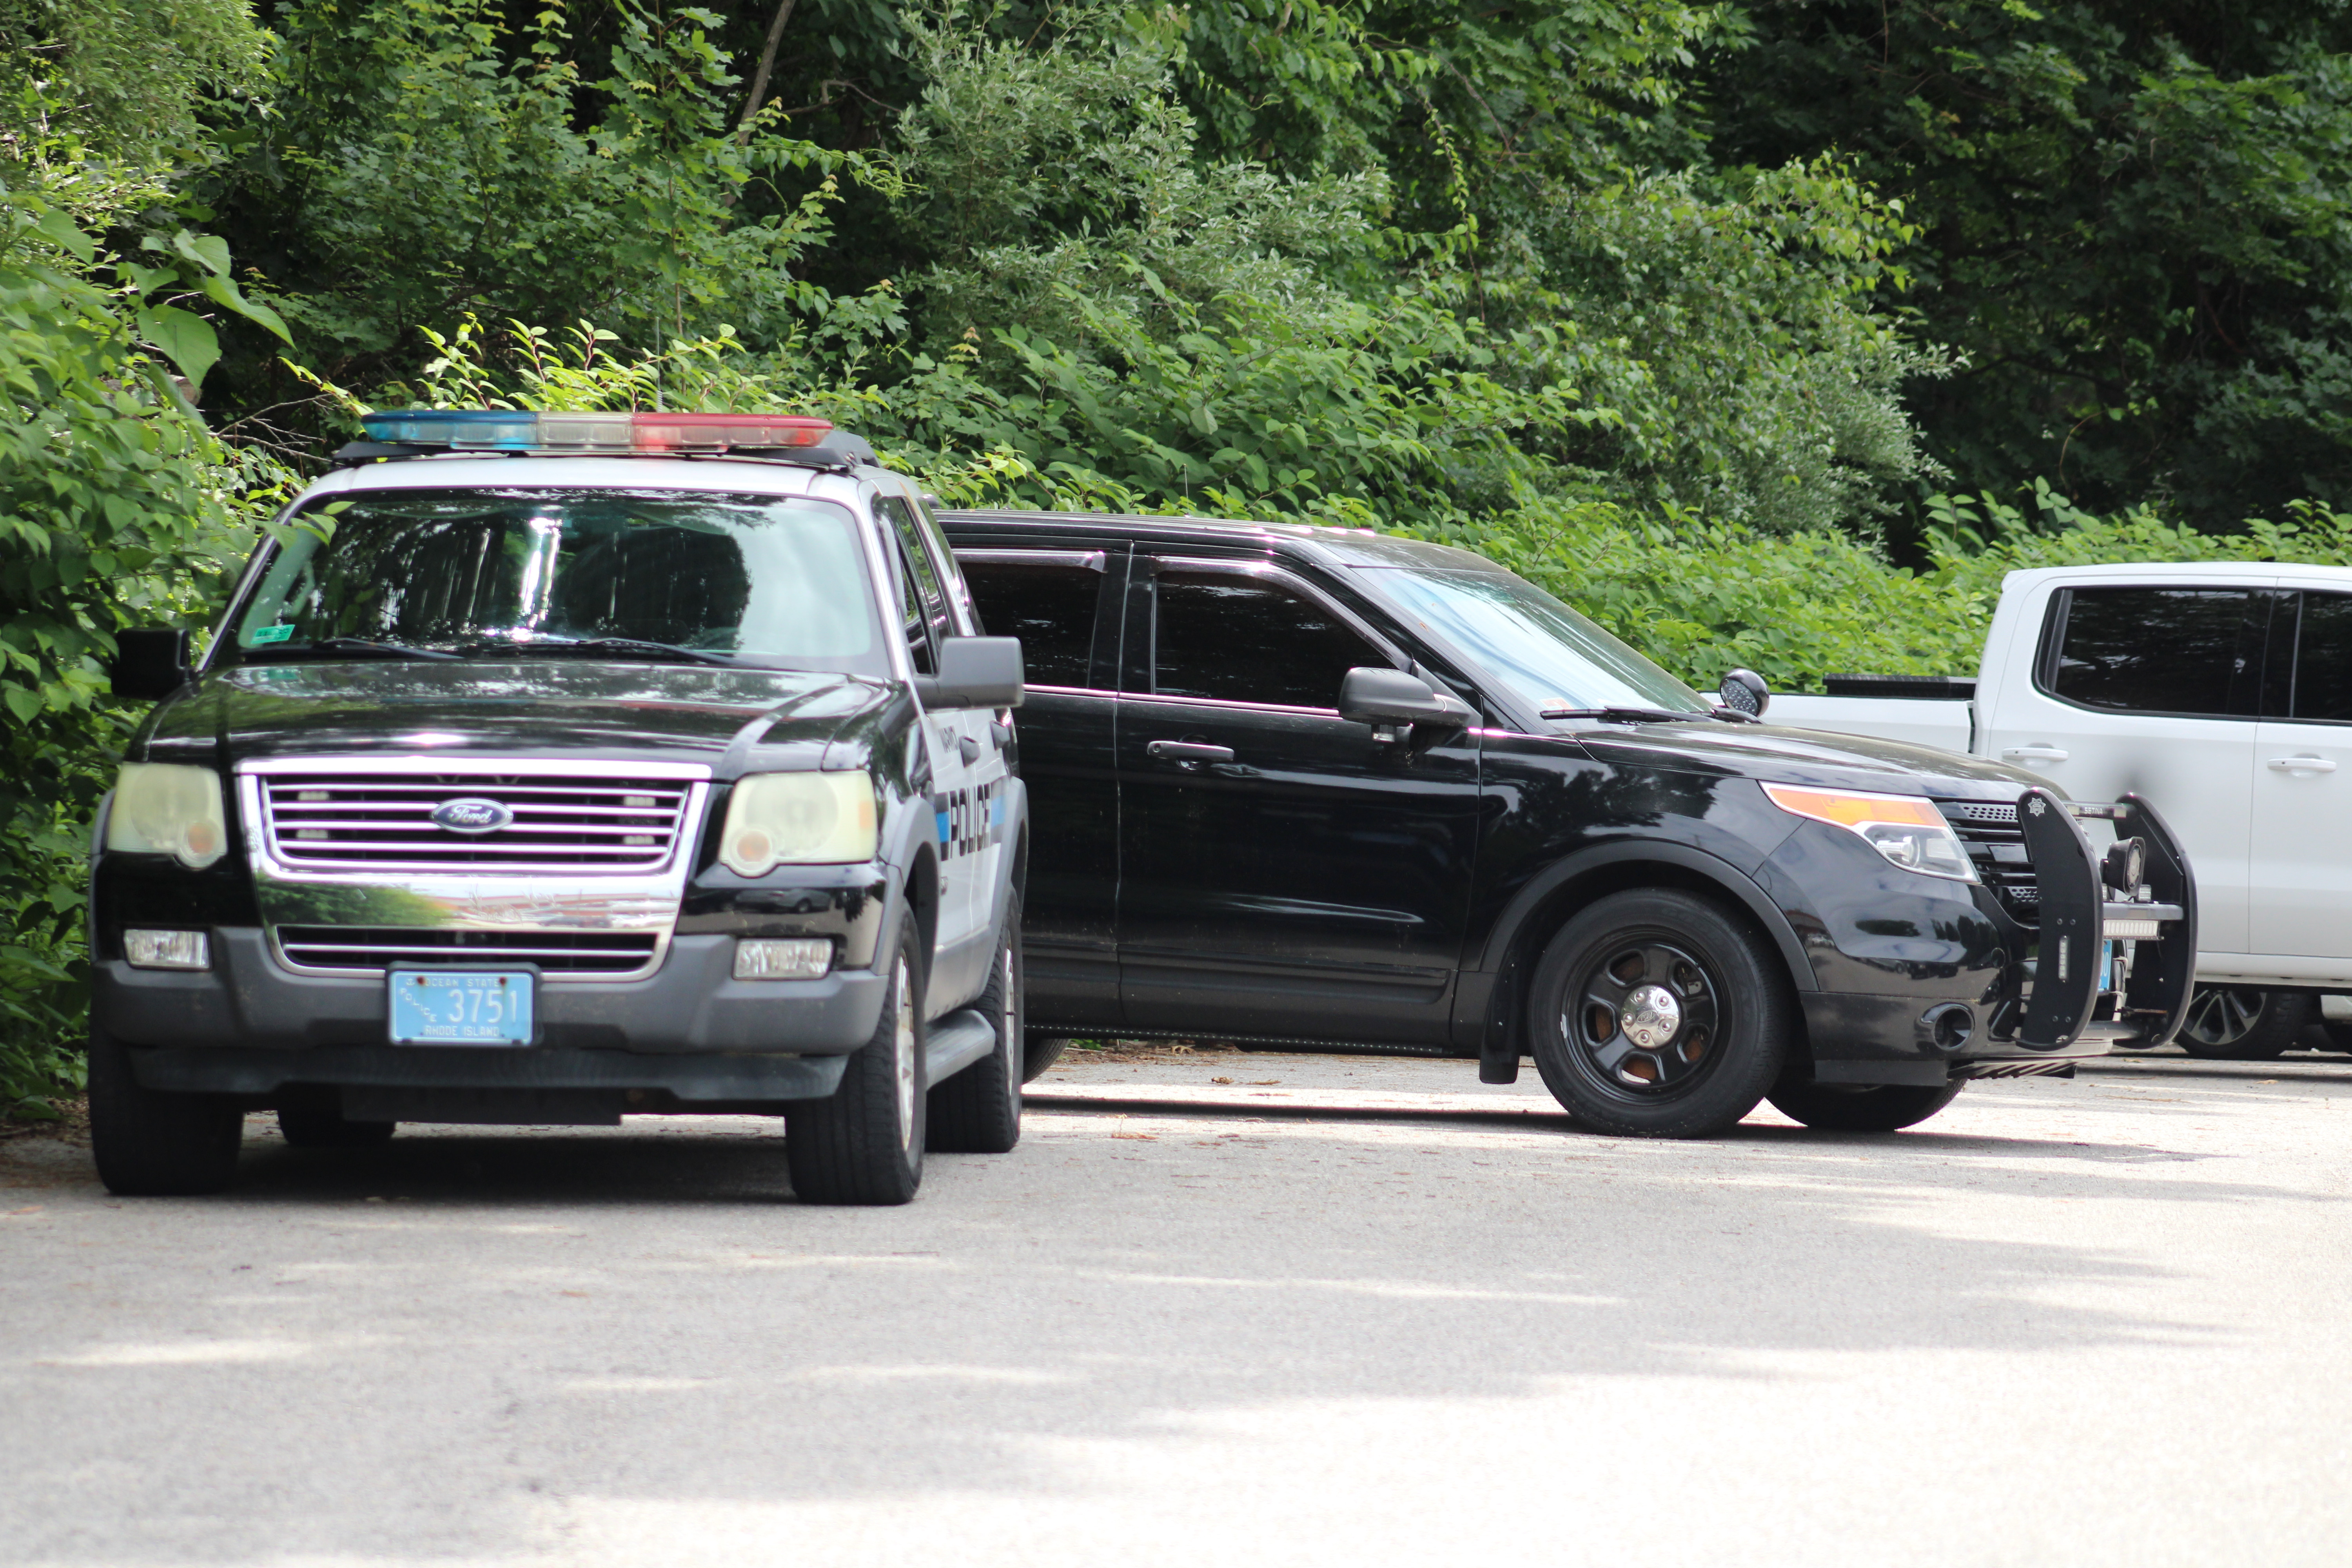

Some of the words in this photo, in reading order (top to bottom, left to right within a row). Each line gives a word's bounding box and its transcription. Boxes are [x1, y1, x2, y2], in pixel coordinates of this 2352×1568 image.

[448, 805, 493, 823] Ford
[2084, 807, 2103, 815] SETINA
[950, 783, 990, 858] POLICE
[425, 979, 459, 987] OCEAN
[467, 979, 499, 987] STATE
[399, 988, 437, 1022] POLICE
[448, 989, 517, 1023] 3751
[425, 1025, 457, 1036] RHODE
[464, 1027, 499, 1037] ISLAND
